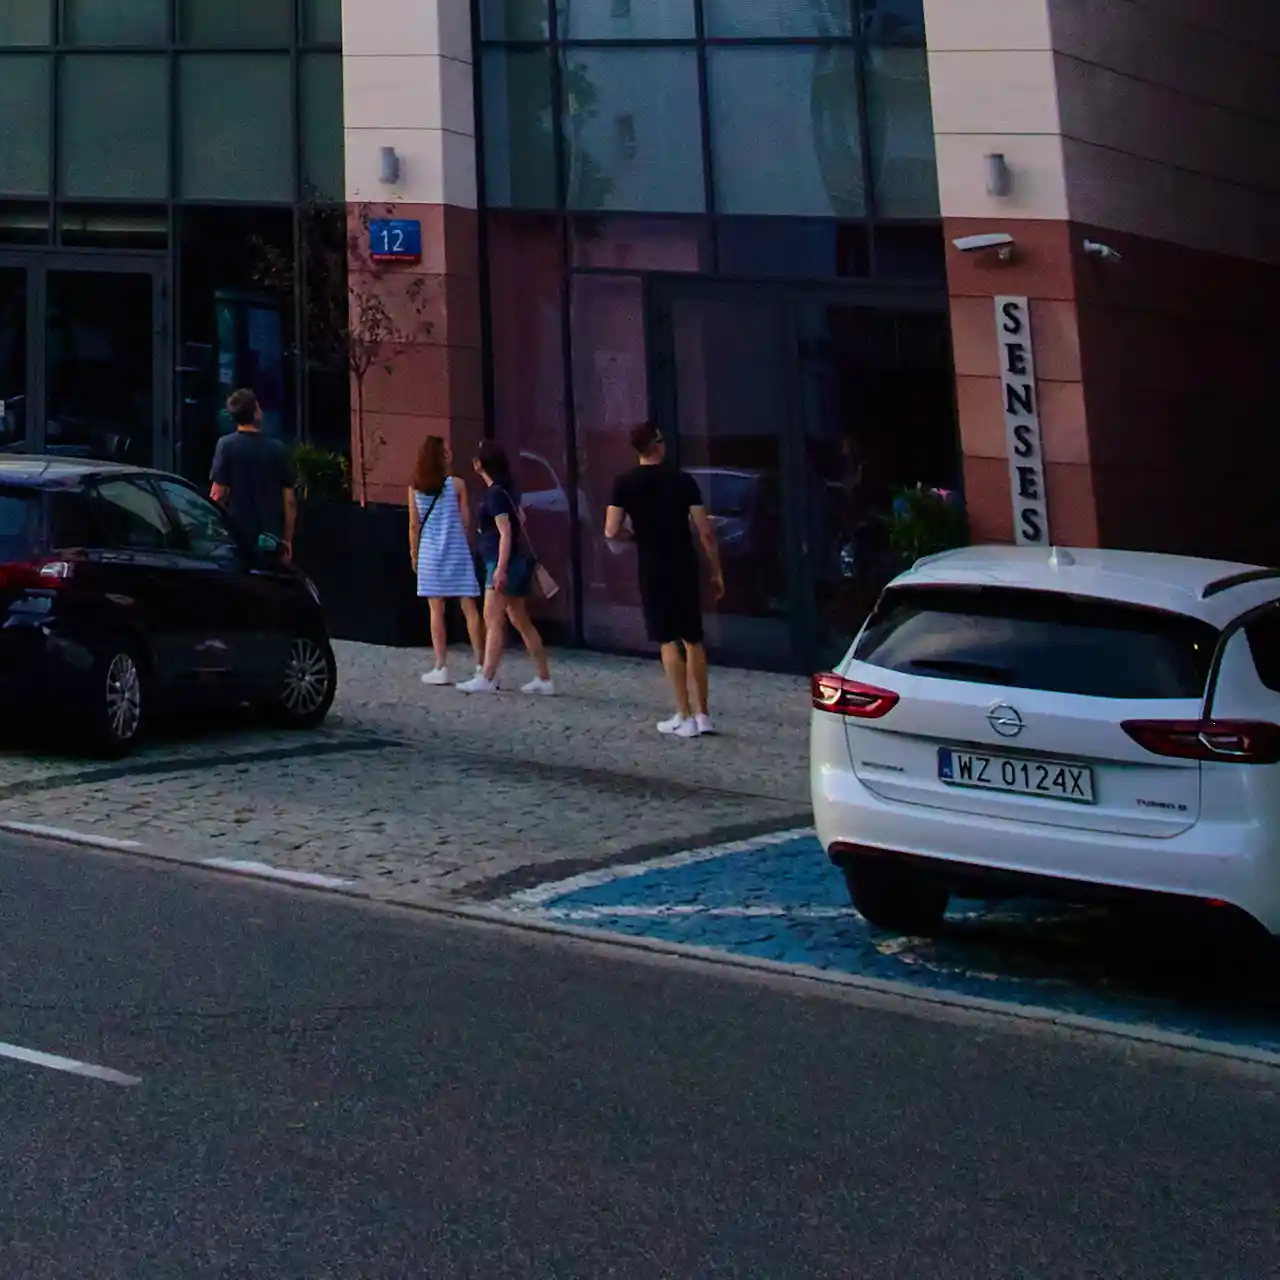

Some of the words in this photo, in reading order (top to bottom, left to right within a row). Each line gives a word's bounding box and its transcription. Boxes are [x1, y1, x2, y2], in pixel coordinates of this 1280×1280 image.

[381, 228, 405, 252] 12
[1002, 302, 1042, 542] SENSES
[958, 754, 991, 784] WZ
[1001, 760, 1085, 797] 0124X
